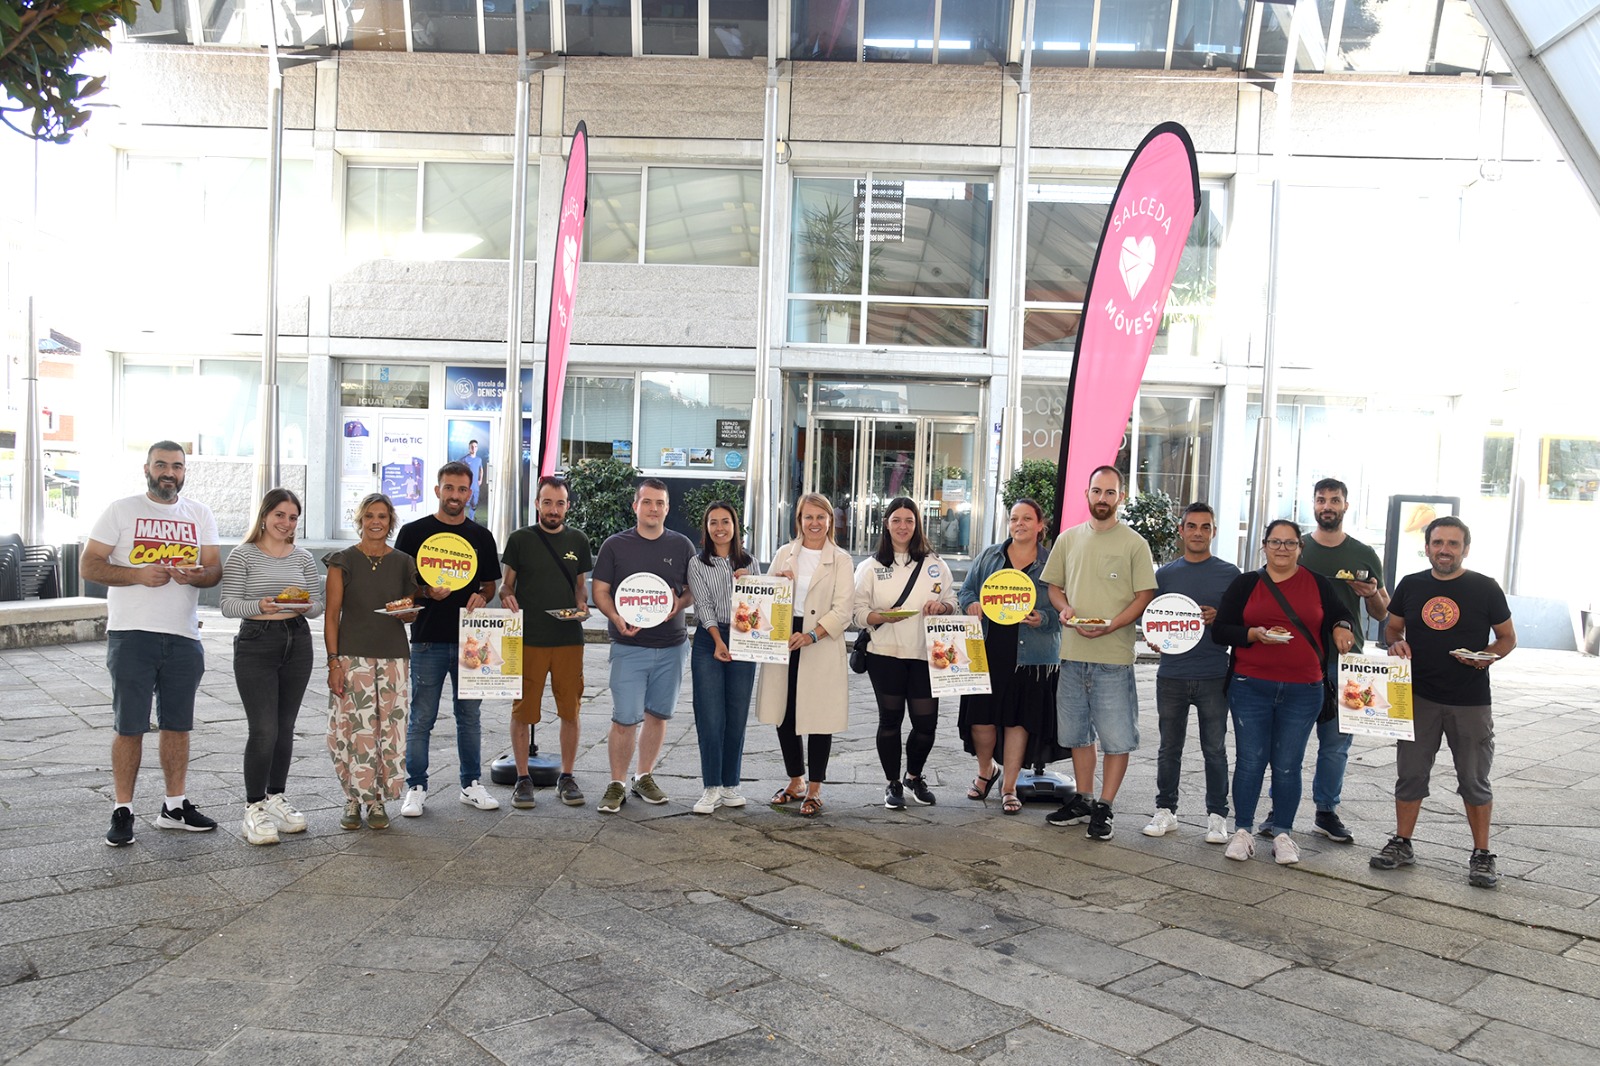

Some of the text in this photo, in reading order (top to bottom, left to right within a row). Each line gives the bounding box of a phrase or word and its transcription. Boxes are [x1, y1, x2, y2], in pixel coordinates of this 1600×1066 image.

[1113, 196, 1172, 235] SALCEDA
[477, 388, 496, 397] DENIS
[358, 397, 410, 406] IGUALDADE
[136, 519, 196, 543] MARVEL
[128, 543, 199, 565] COMICS
[421, 557, 471, 571] PINCHO
[441, 567, 470, 580] FOLK
[735, 585, 774, 595] PINCHO
[773, 585, 791, 601] Folk
[619, 595, 668, 606] PINCHO
[983, 592, 1031, 605] PINCHO
[1002, 602, 1030, 611] FOLK
[462, 619, 503, 628] PINCHO
[502, 617, 522, 634] Folk
[927, 624, 965, 633] PINCHO
[964, 623, 982, 637] Folk
[1146, 619, 1200, 633] PINCHO
[1168, 631, 1200, 641] FOLK
[1341, 663, 1389, 674] PINCHO
[1386, 664, 1410, 680] Folk
